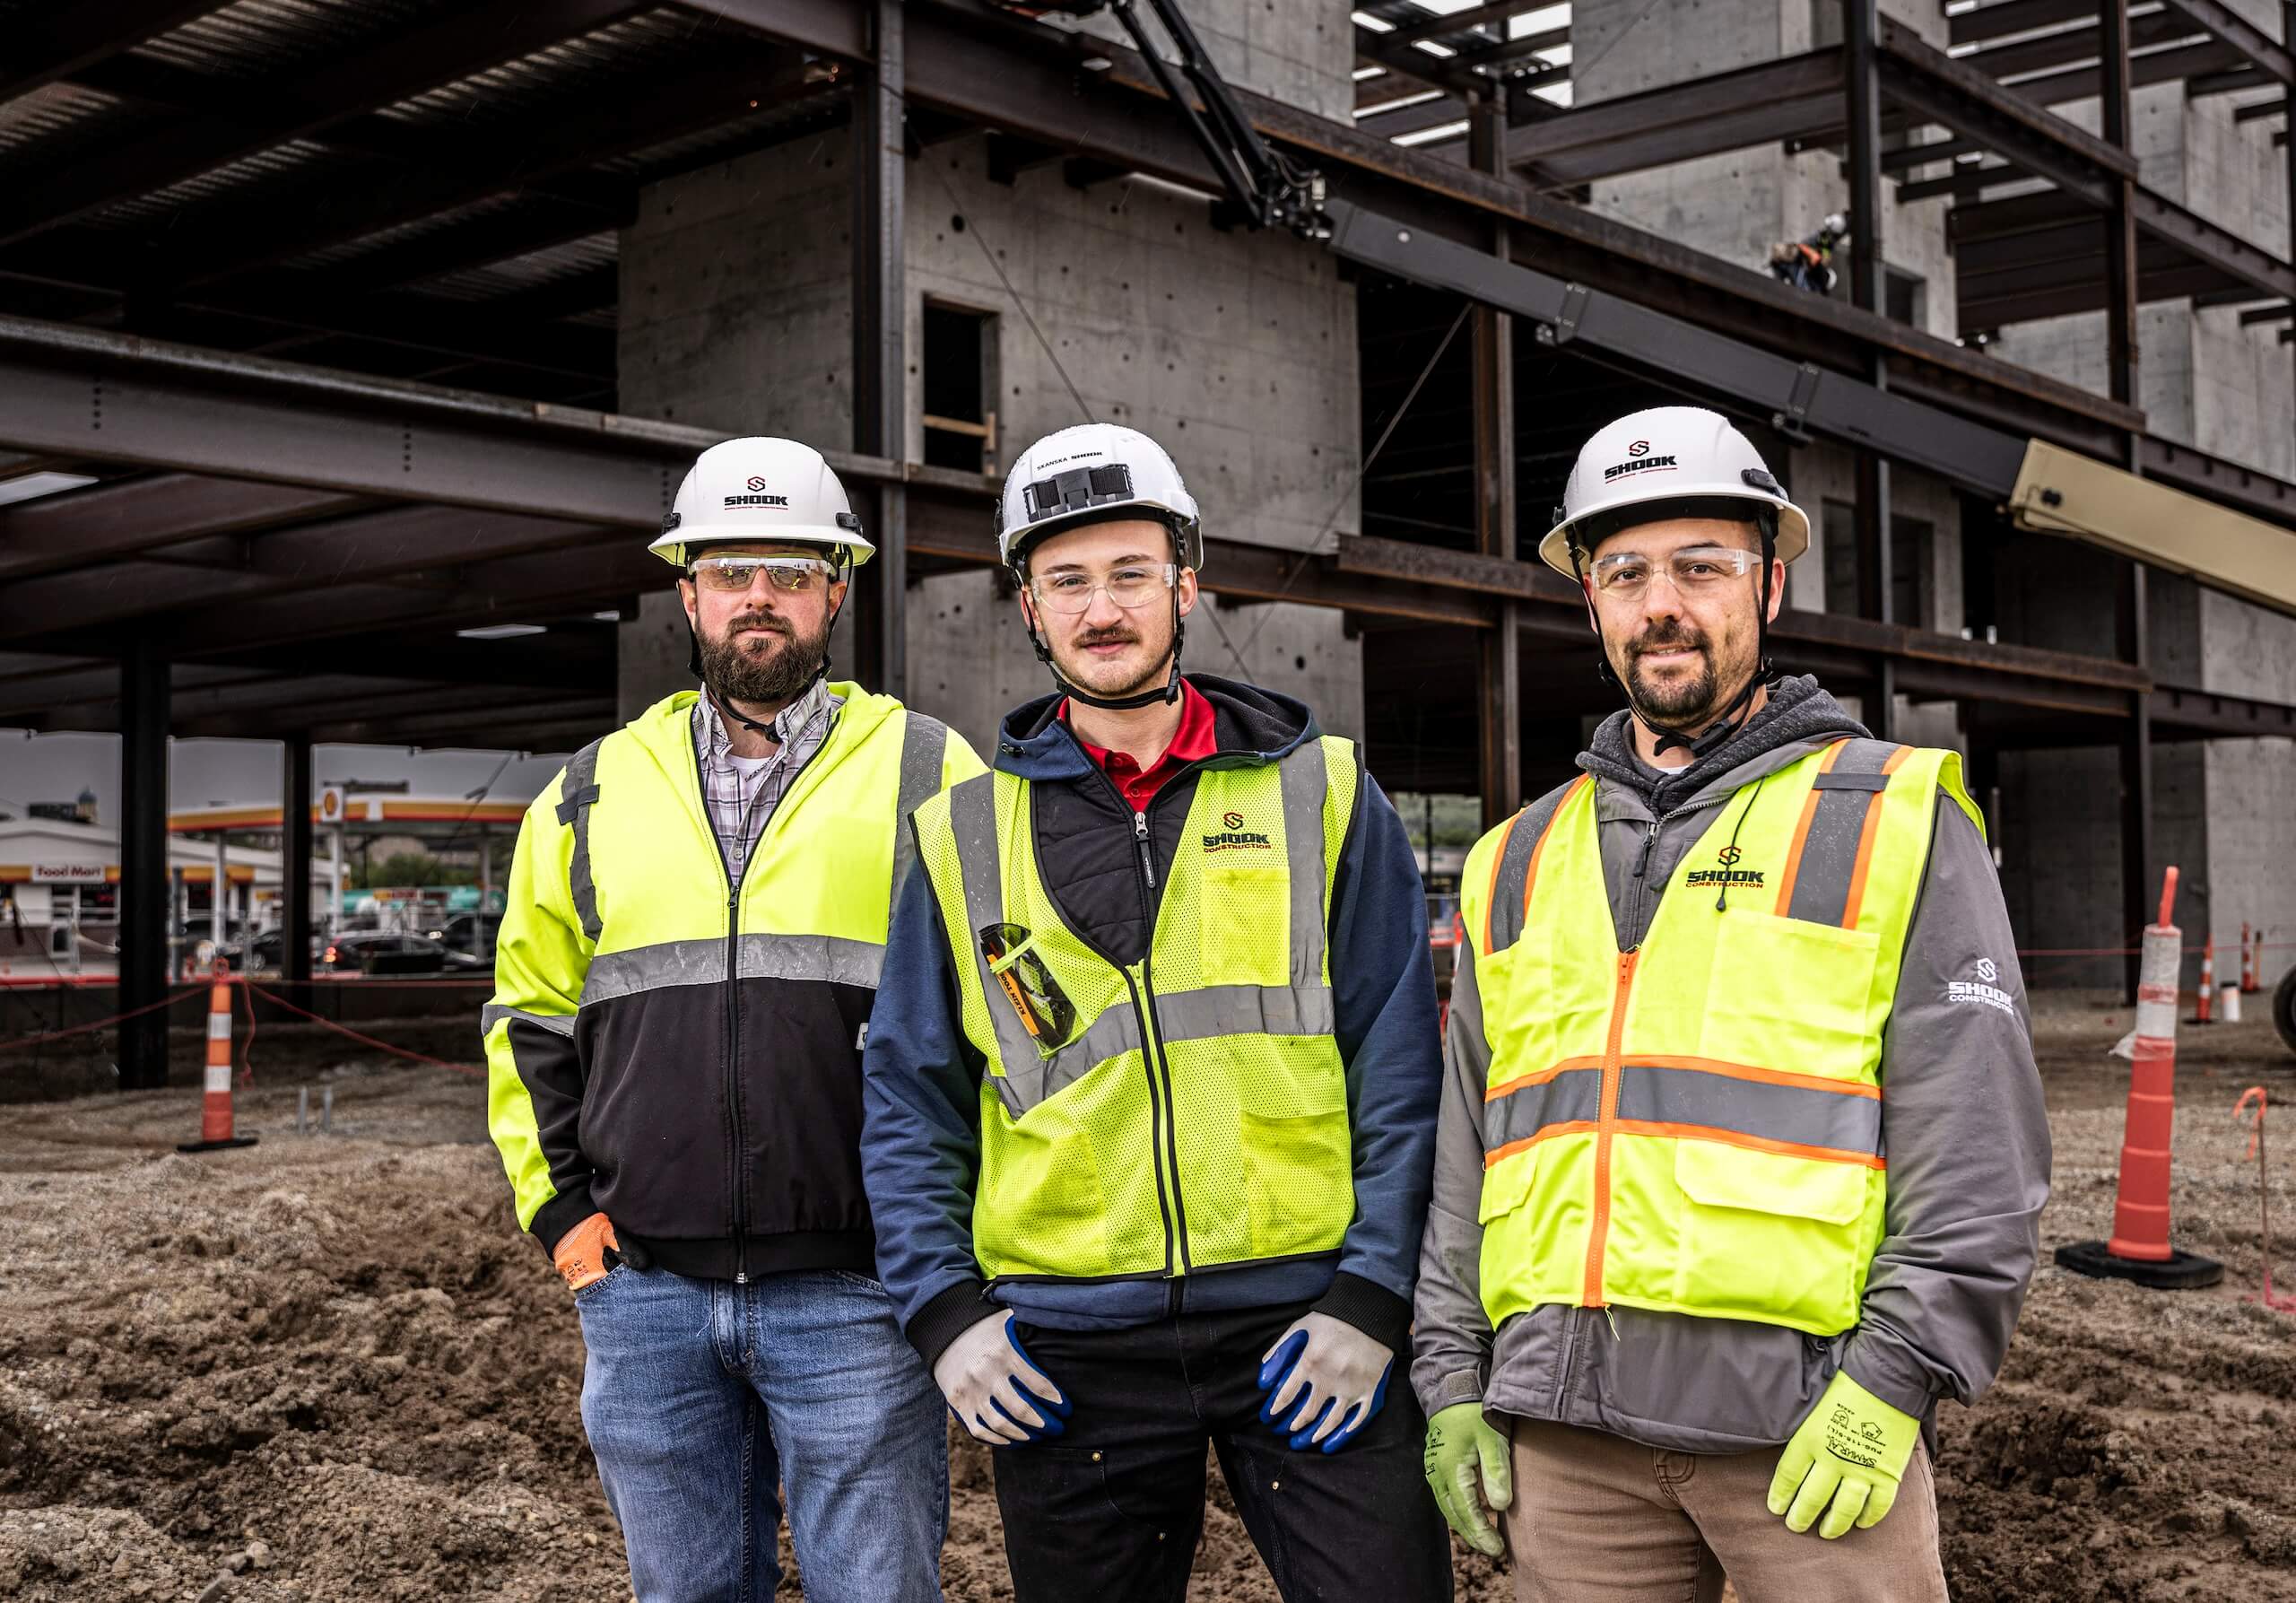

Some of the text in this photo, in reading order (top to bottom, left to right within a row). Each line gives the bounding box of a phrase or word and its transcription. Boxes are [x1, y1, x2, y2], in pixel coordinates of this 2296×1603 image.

[1071, 451, 1103, 459] SHOOK
[1605, 456, 1677, 479] SHOOK
[724, 494, 789, 506] SHOOK
[1203, 832, 1270, 847] SHOOK
[1204, 843, 1272, 853] CONSTRUCTION
[38, 864, 101, 876] Food Mart
[1686, 870, 1764, 883] SHOOK
[1685, 881, 1763, 889] CONSTRUCTION
[1011, 992, 1026, 1015] KLEIN
